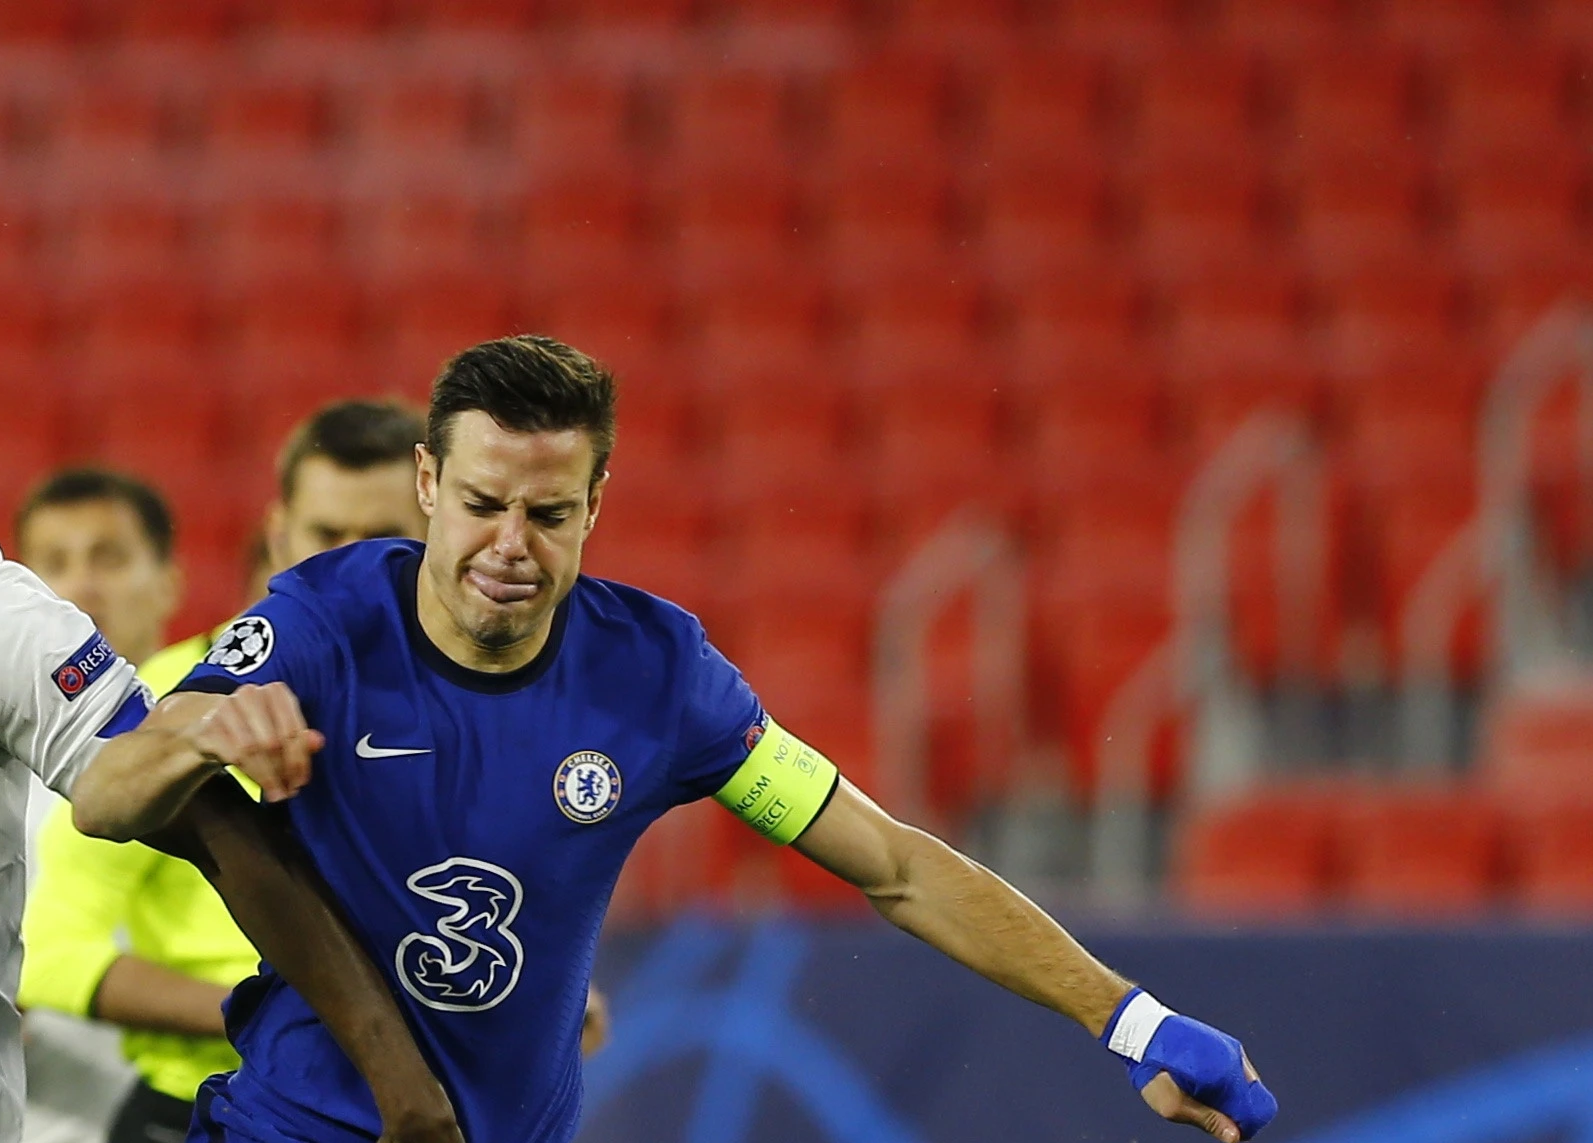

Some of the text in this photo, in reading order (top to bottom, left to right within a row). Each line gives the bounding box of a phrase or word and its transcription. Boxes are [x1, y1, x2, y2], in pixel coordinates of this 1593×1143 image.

[566, 754, 611, 771] CHELSEA
[732, 774, 772, 815] ACISM
[754, 798, 788, 833] PECT
